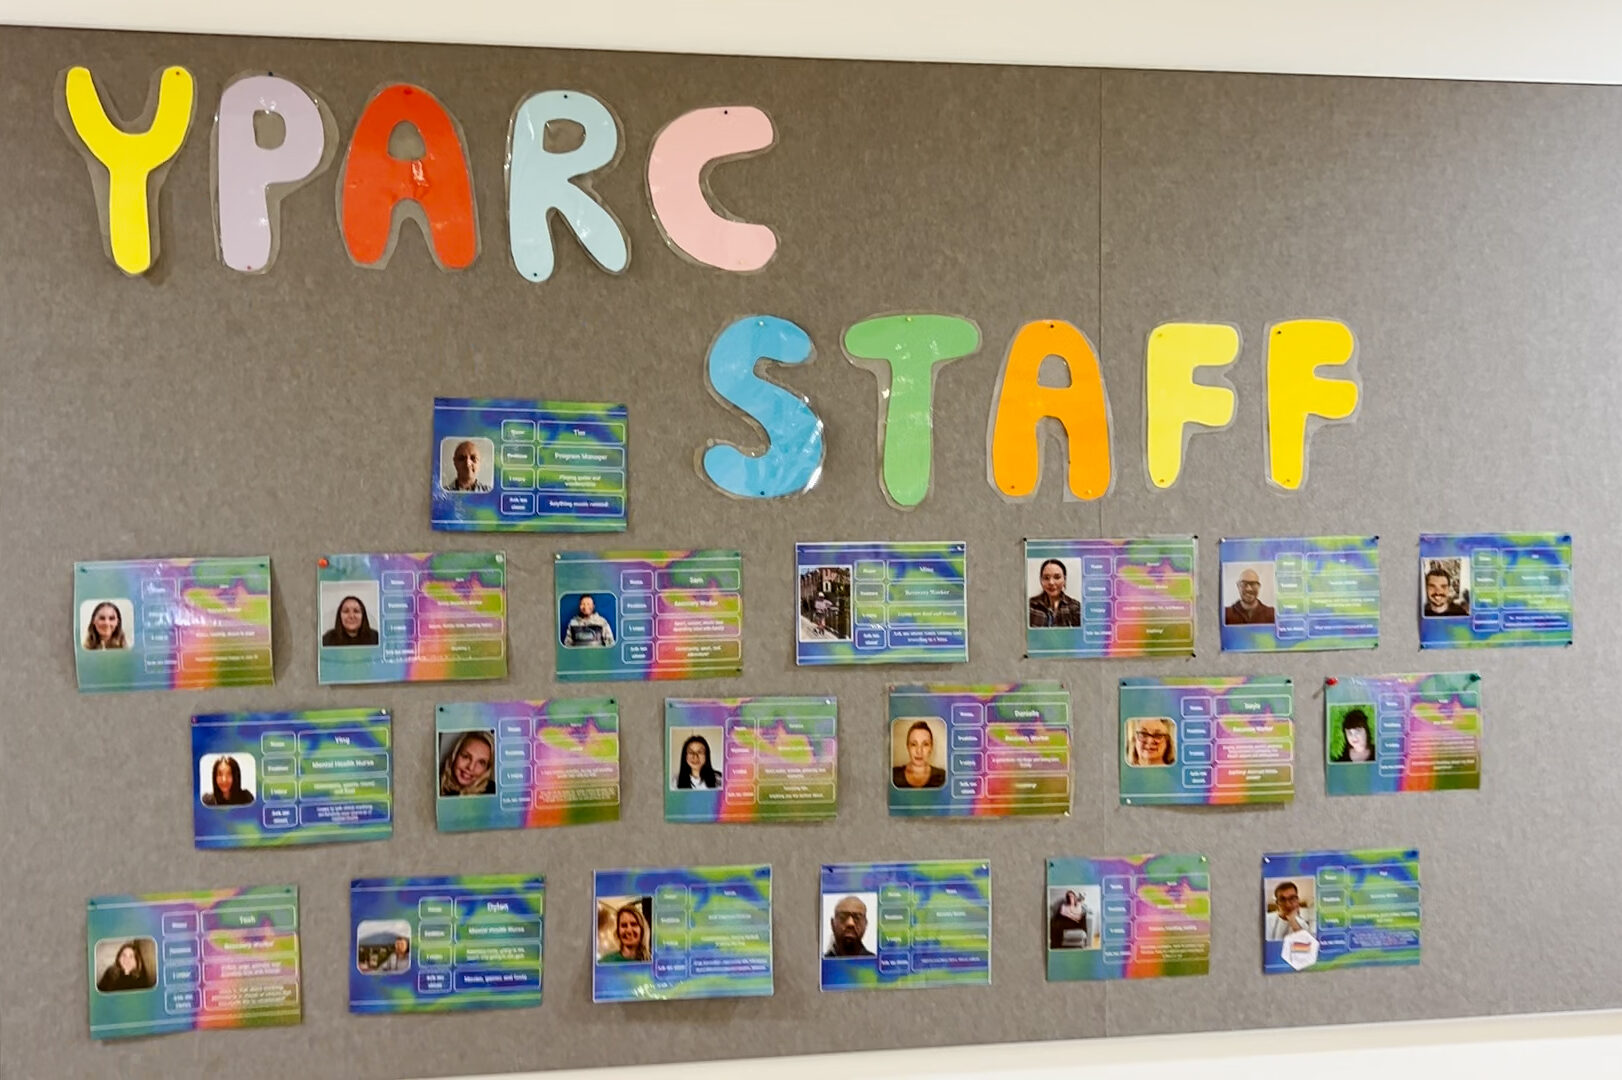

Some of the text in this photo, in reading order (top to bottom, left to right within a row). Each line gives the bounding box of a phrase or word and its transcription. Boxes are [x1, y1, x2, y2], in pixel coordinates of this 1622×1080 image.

[65, 66, 777, 282] YPARC
[704, 315, 1358, 505] STAFF
[554, 452, 608, 462] Program Manager
[334, 736, 351, 745] Ying
[487, 902, 509, 913] Dylan
